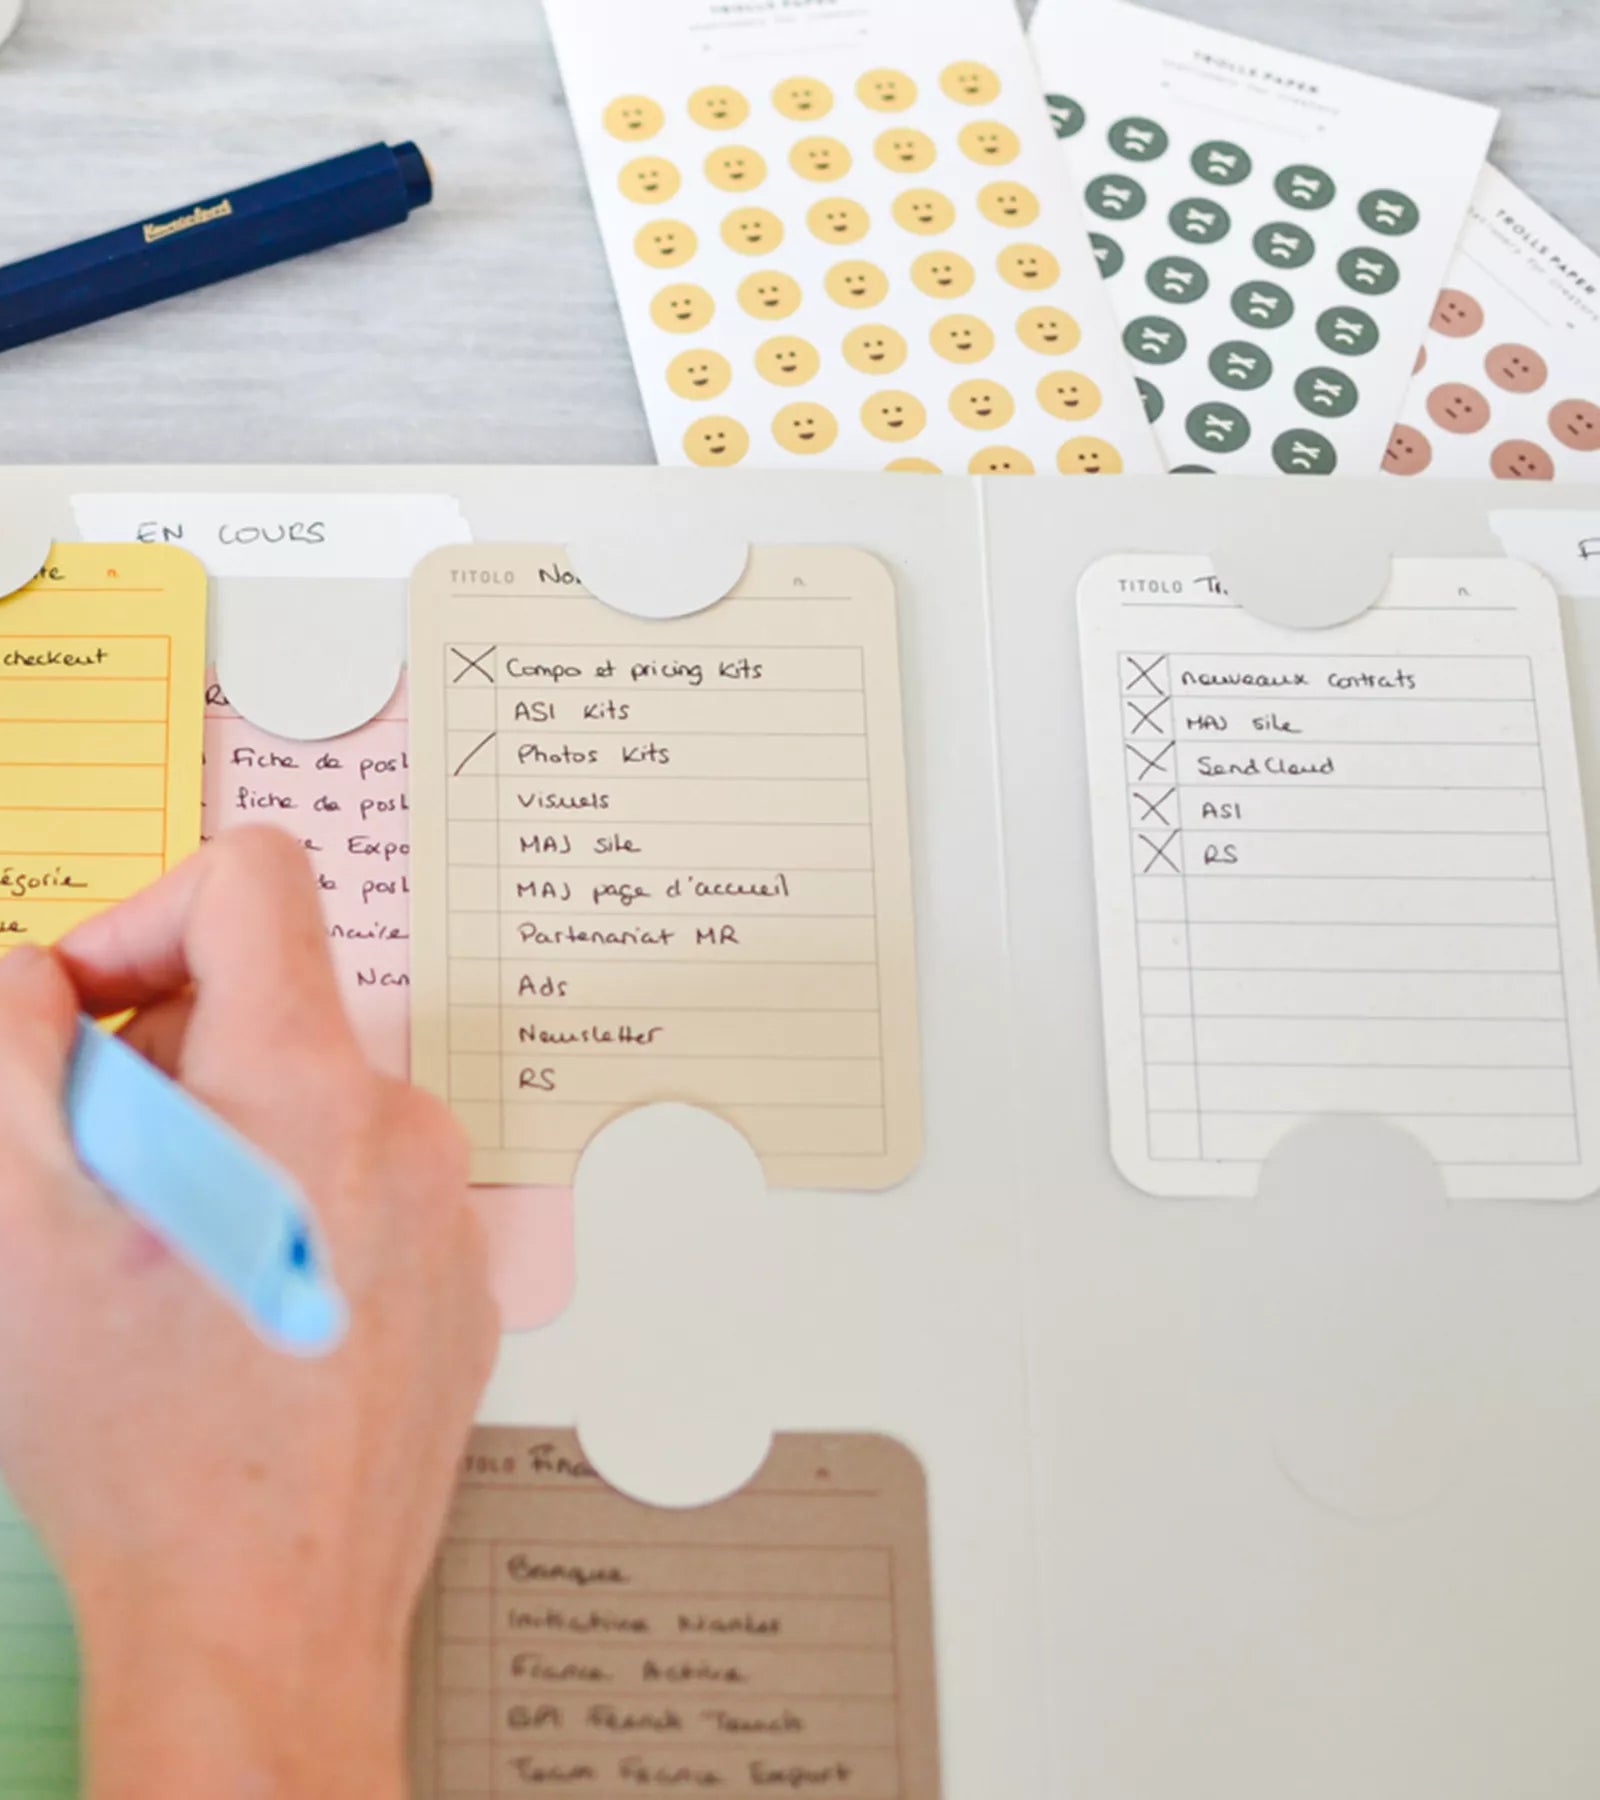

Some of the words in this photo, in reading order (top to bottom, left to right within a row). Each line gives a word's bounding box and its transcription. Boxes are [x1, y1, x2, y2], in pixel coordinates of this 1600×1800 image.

[1549, 255, 1597, 295] PAPER
[136, 521, 184, 545] EN
[218, 521, 326, 545] COURS
[450, 570, 515, 585] TITOLO
[1118, 579, 1183, 594] TITOLO
[630, 659, 703, 686] pricing
[517, 743, 599, 766] Photos
[519, 835, 572, 855] MAJ
[517, 880, 572, 900] MAJ
[593, 882, 651, 906] page
[517, 922, 676, 946] Partenariat
[695, 925, 740, 945] MR
[518, 974, 569, 998] Ads
[518, 1024, 666, 1046] Newsletter
[518, 1068, 557, 1092] RS
